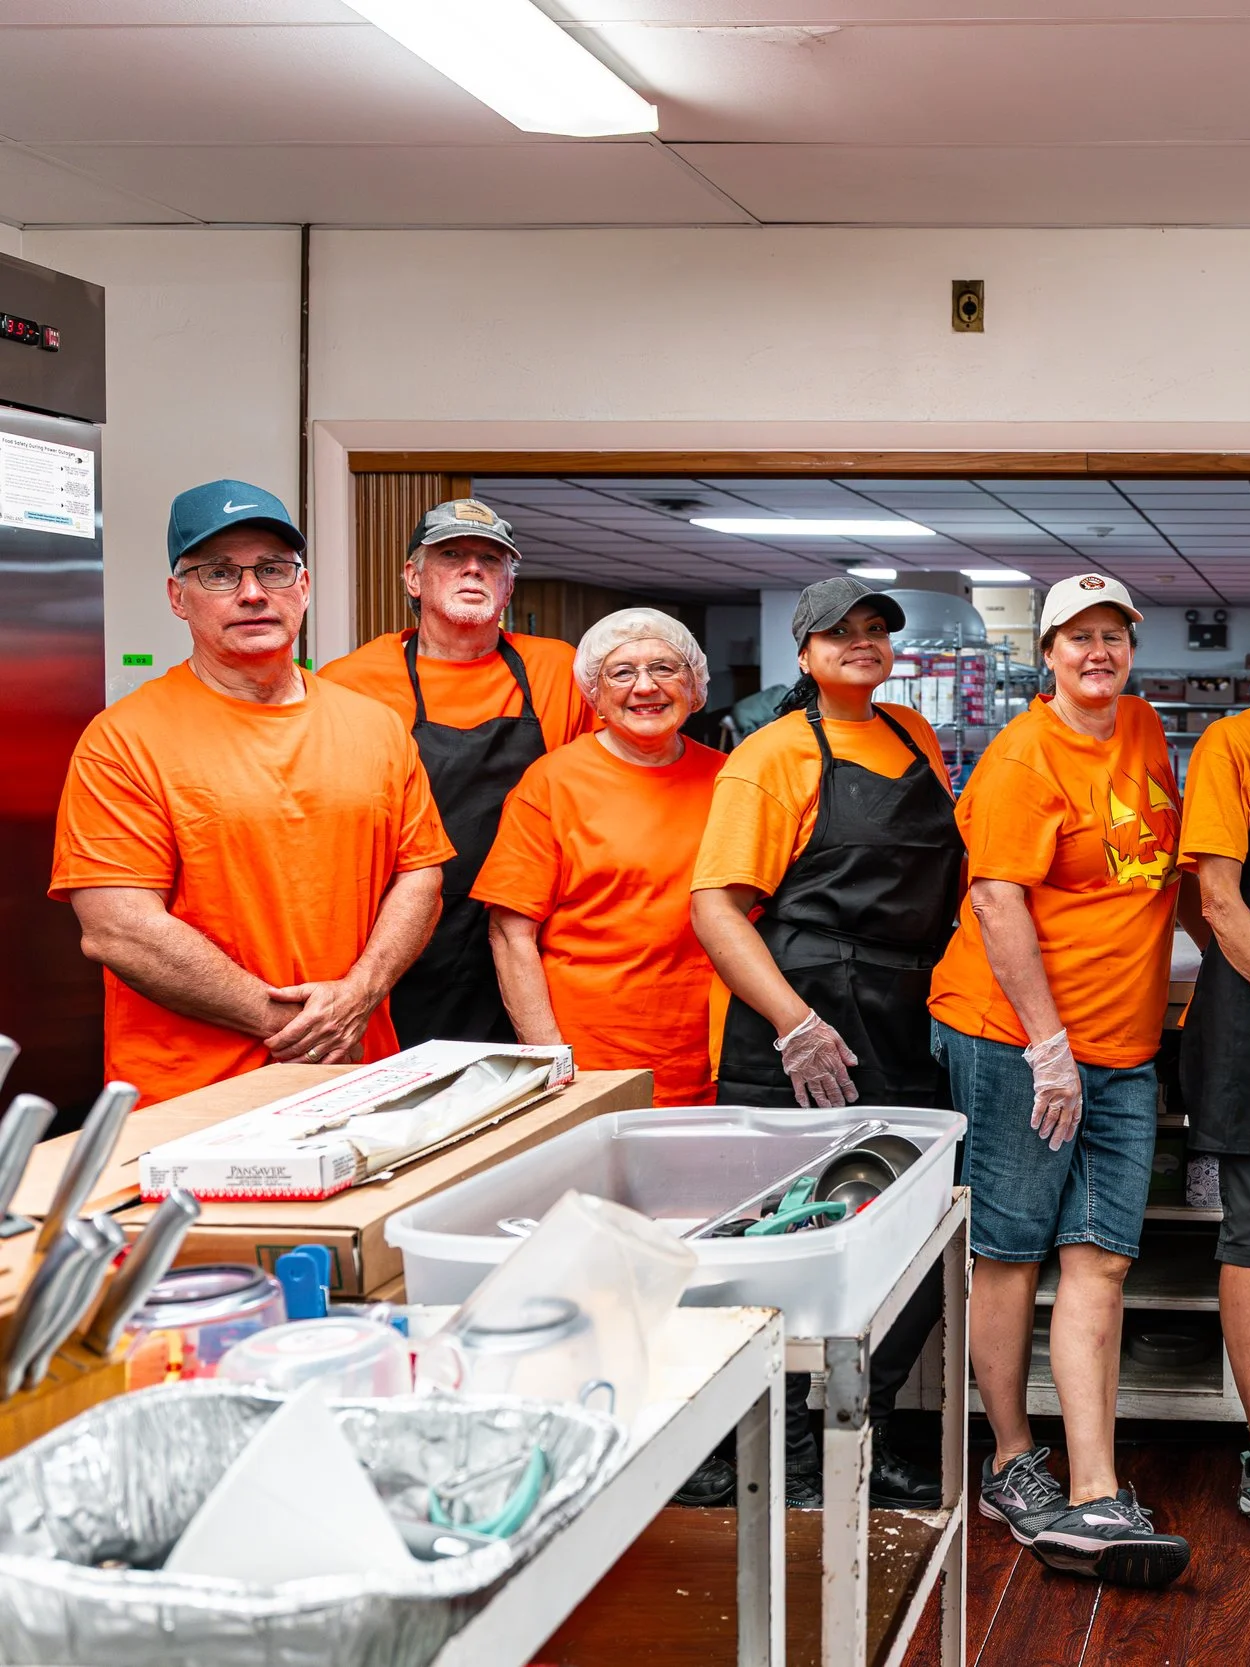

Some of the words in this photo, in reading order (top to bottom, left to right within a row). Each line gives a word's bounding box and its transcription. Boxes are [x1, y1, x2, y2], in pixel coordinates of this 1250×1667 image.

[14, 440, 28, 448] Safety
[29, 443, 44, 452] During
[58, 449, 76, 457] Outages
